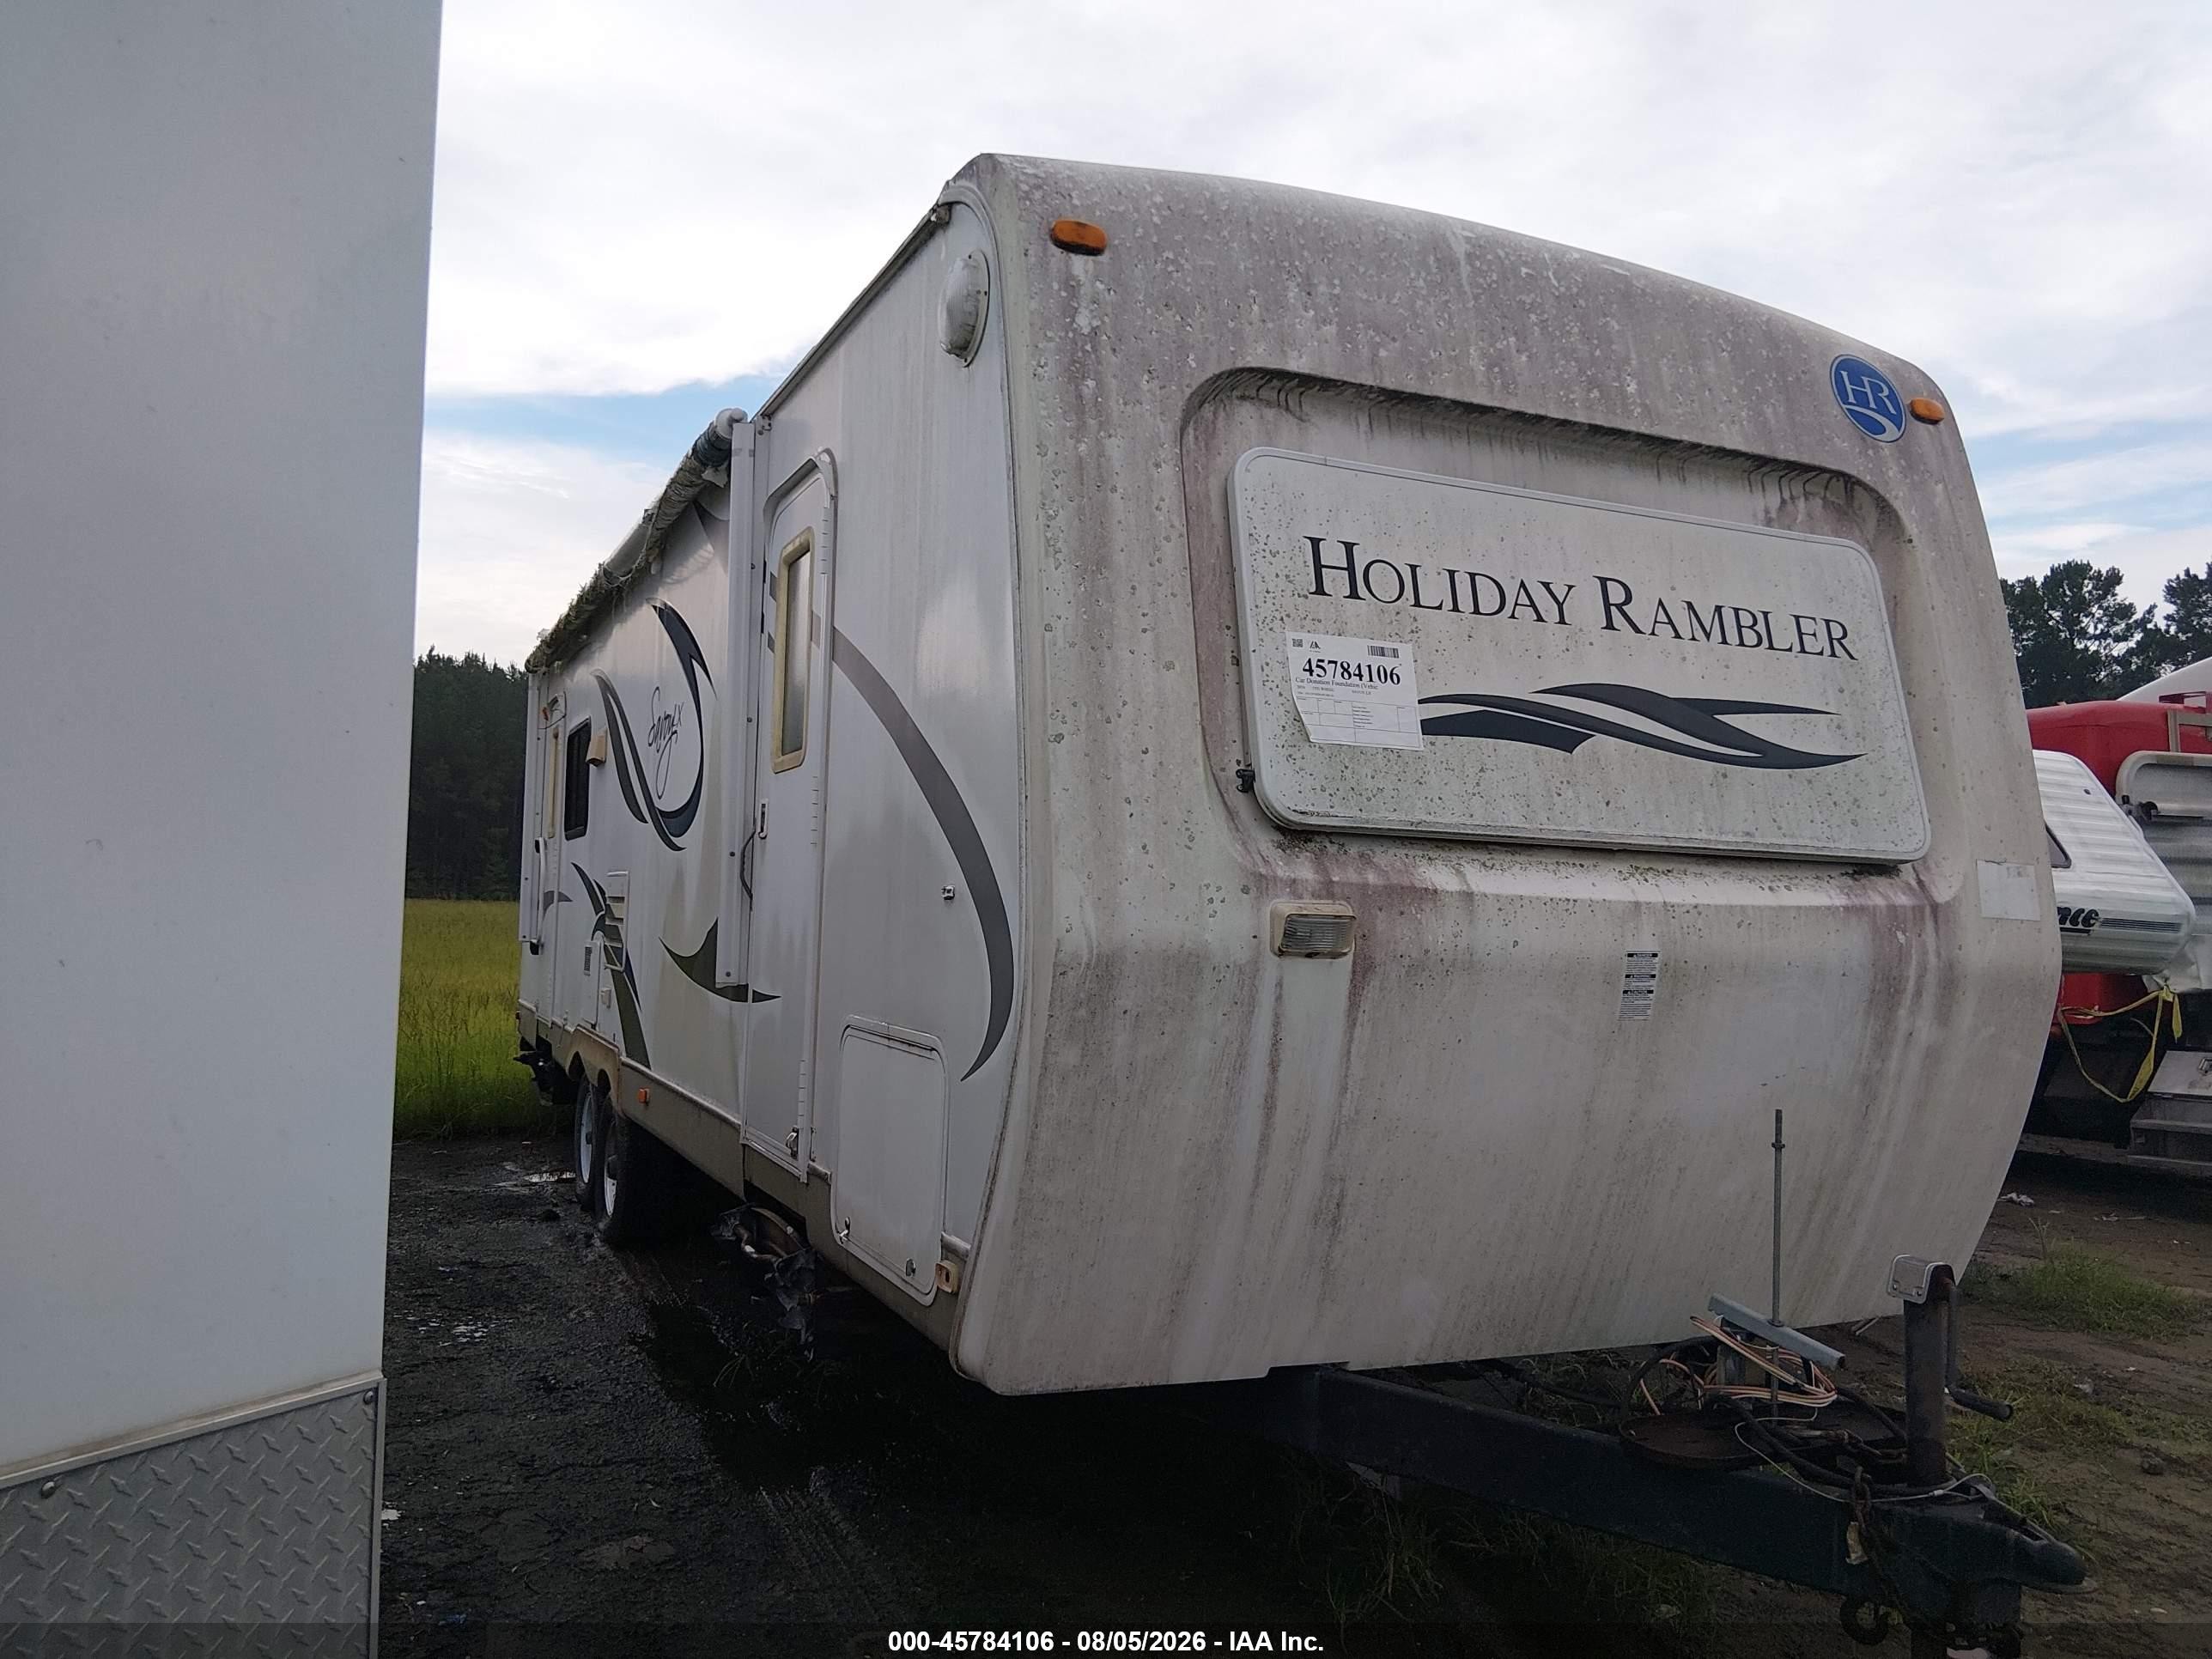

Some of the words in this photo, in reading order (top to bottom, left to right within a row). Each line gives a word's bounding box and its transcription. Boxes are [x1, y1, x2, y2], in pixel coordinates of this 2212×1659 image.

[1839, 370, 1897, 415] HR
[1303, 535, 1577, 626] HOLIDAY
[1592, 574, 1859, 661] RAMBLER
[1302, 657, 1401, 685] 45784106
[1306, 678, 1331, 686] Donation
[1331, 679, 1360, 689] Foundation
